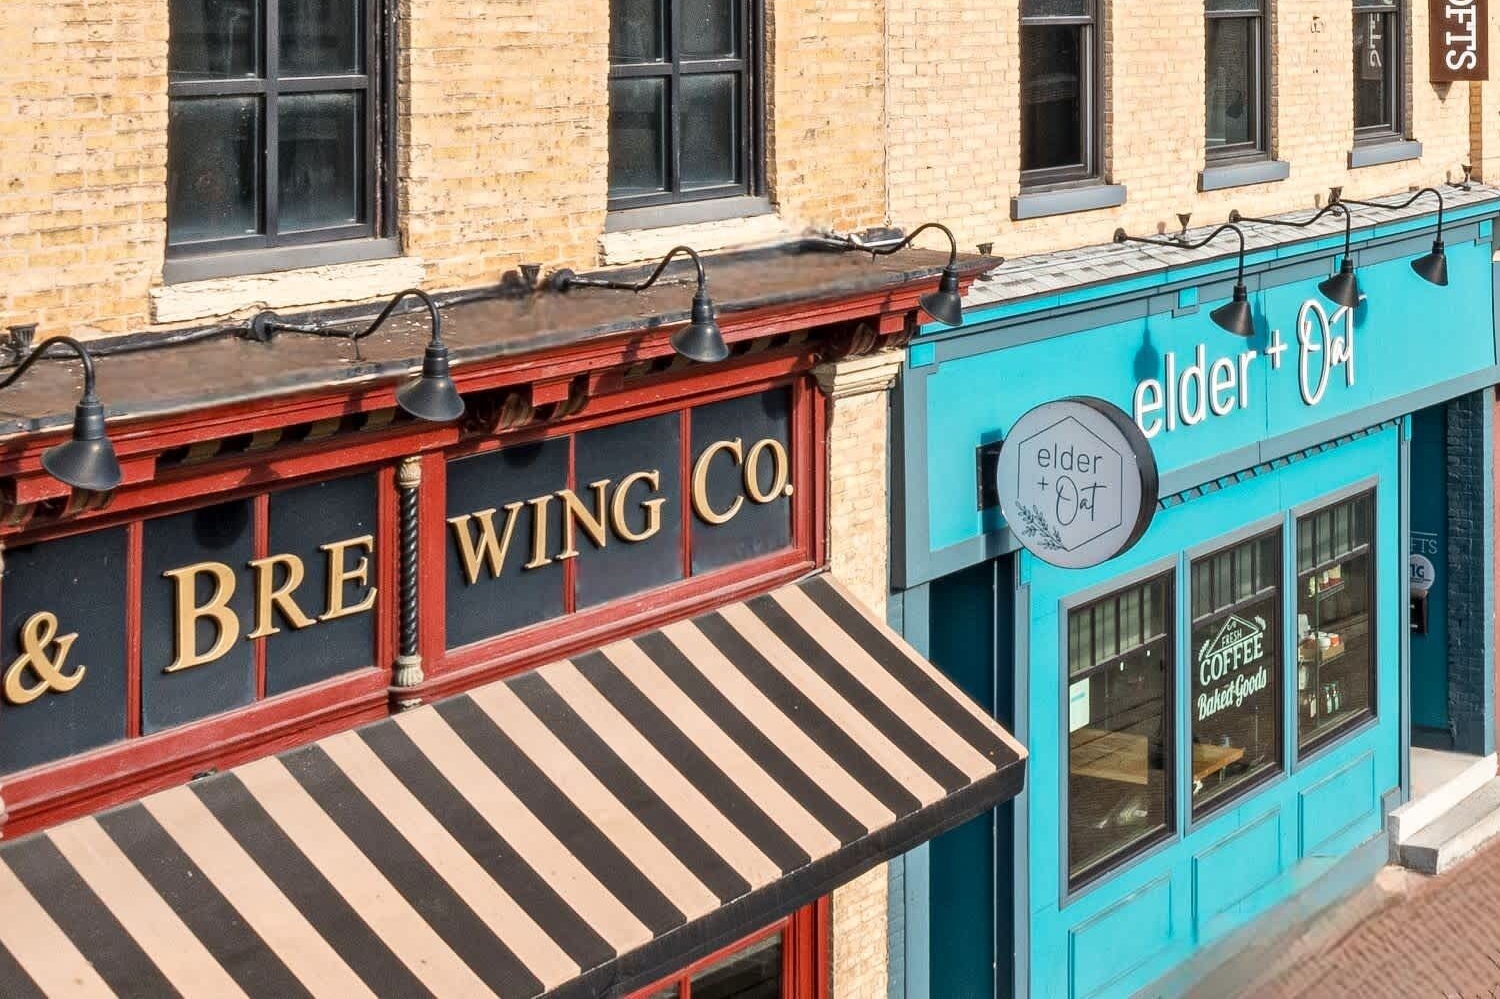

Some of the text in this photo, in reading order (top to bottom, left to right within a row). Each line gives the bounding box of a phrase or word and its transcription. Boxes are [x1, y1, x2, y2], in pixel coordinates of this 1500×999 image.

[1134, 343, 1258, 439] elder
[1037, 444, 1104, 474] elder
[5, 611, 87, 707] &
[1200, 632, 1264, 686] COFFEE
[1221, 628, 1243, 648] FRESH
[1198, 665, 1267, 722] Baked Goods
